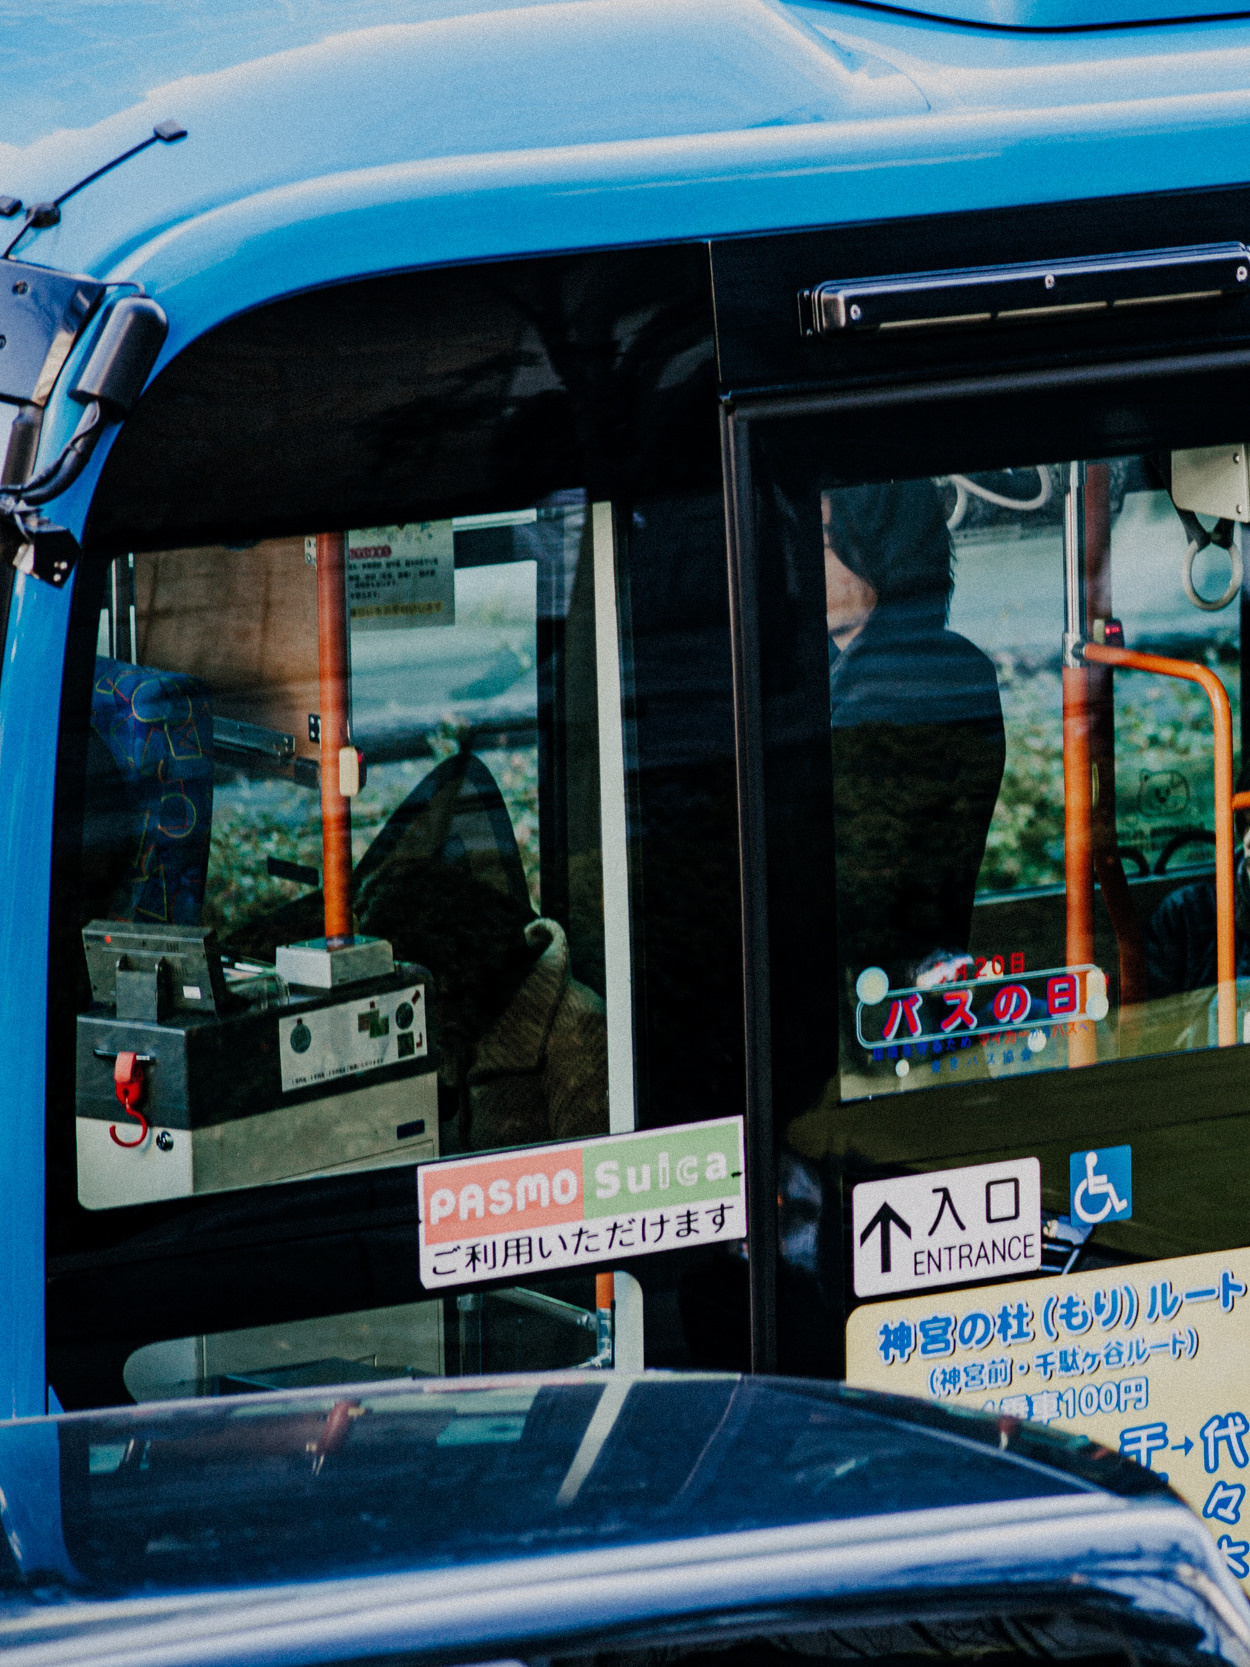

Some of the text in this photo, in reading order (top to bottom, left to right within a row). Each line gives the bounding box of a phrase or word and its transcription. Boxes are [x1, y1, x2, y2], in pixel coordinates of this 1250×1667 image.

[934, 952, 1025, 984] 月20日
[882, 973, 1081, 1042] バスの日
[430, 1151, 727, 1226] PASMO Suica
[928, 1177, 1020, 1237] 入口
[432, 1203, 735, 1276] ご利用いただけます
[913, 1233, 1035, 1277] ENTRANCE
